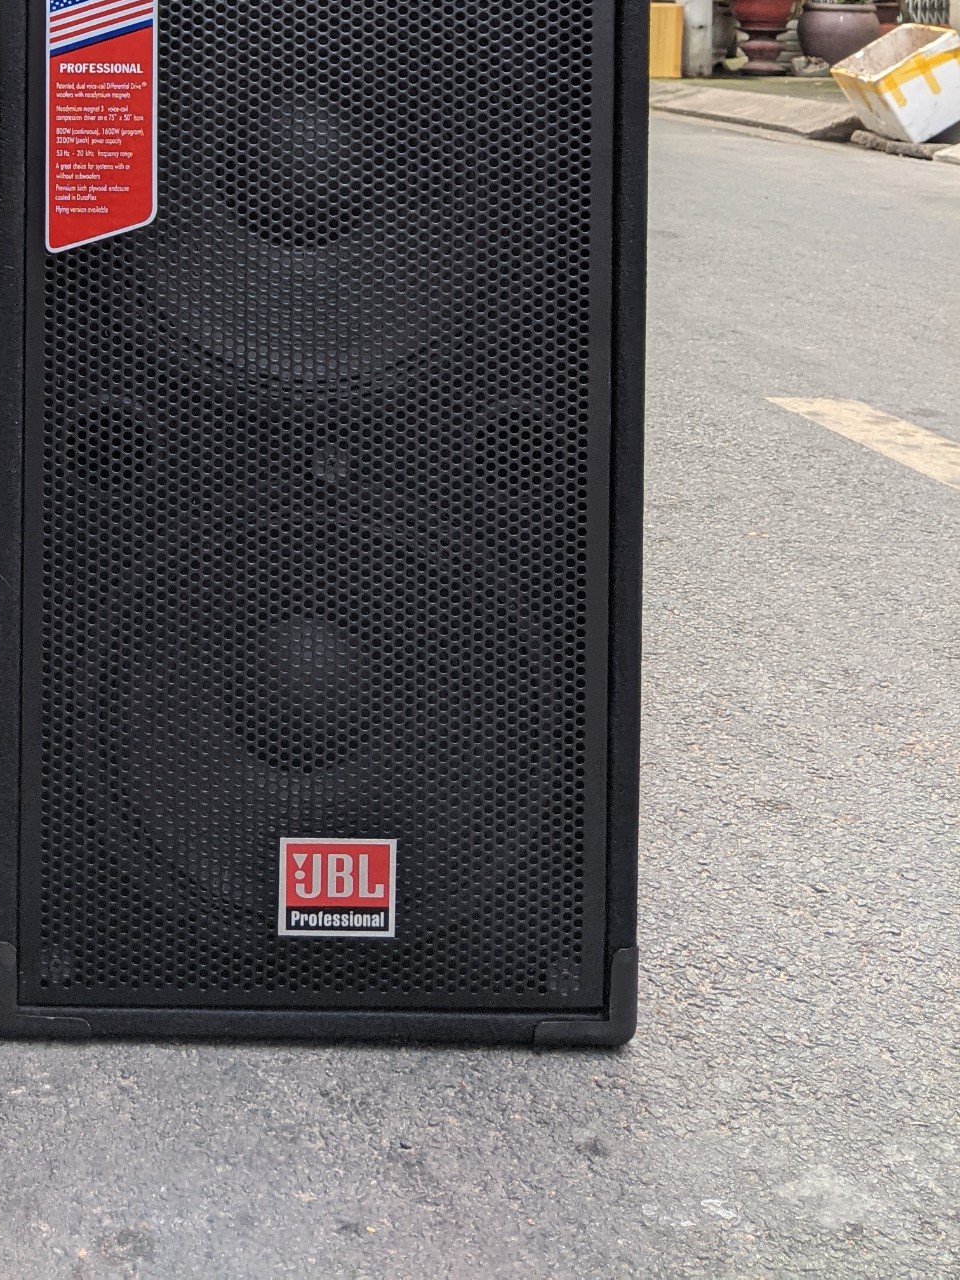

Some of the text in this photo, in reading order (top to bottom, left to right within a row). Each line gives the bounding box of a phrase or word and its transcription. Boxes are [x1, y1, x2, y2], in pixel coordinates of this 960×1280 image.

[60, 63, 143, 74] PROFESSIONAL
[292, 853, 385, 899] JBL
[290, 910, 385, 928] Professional
